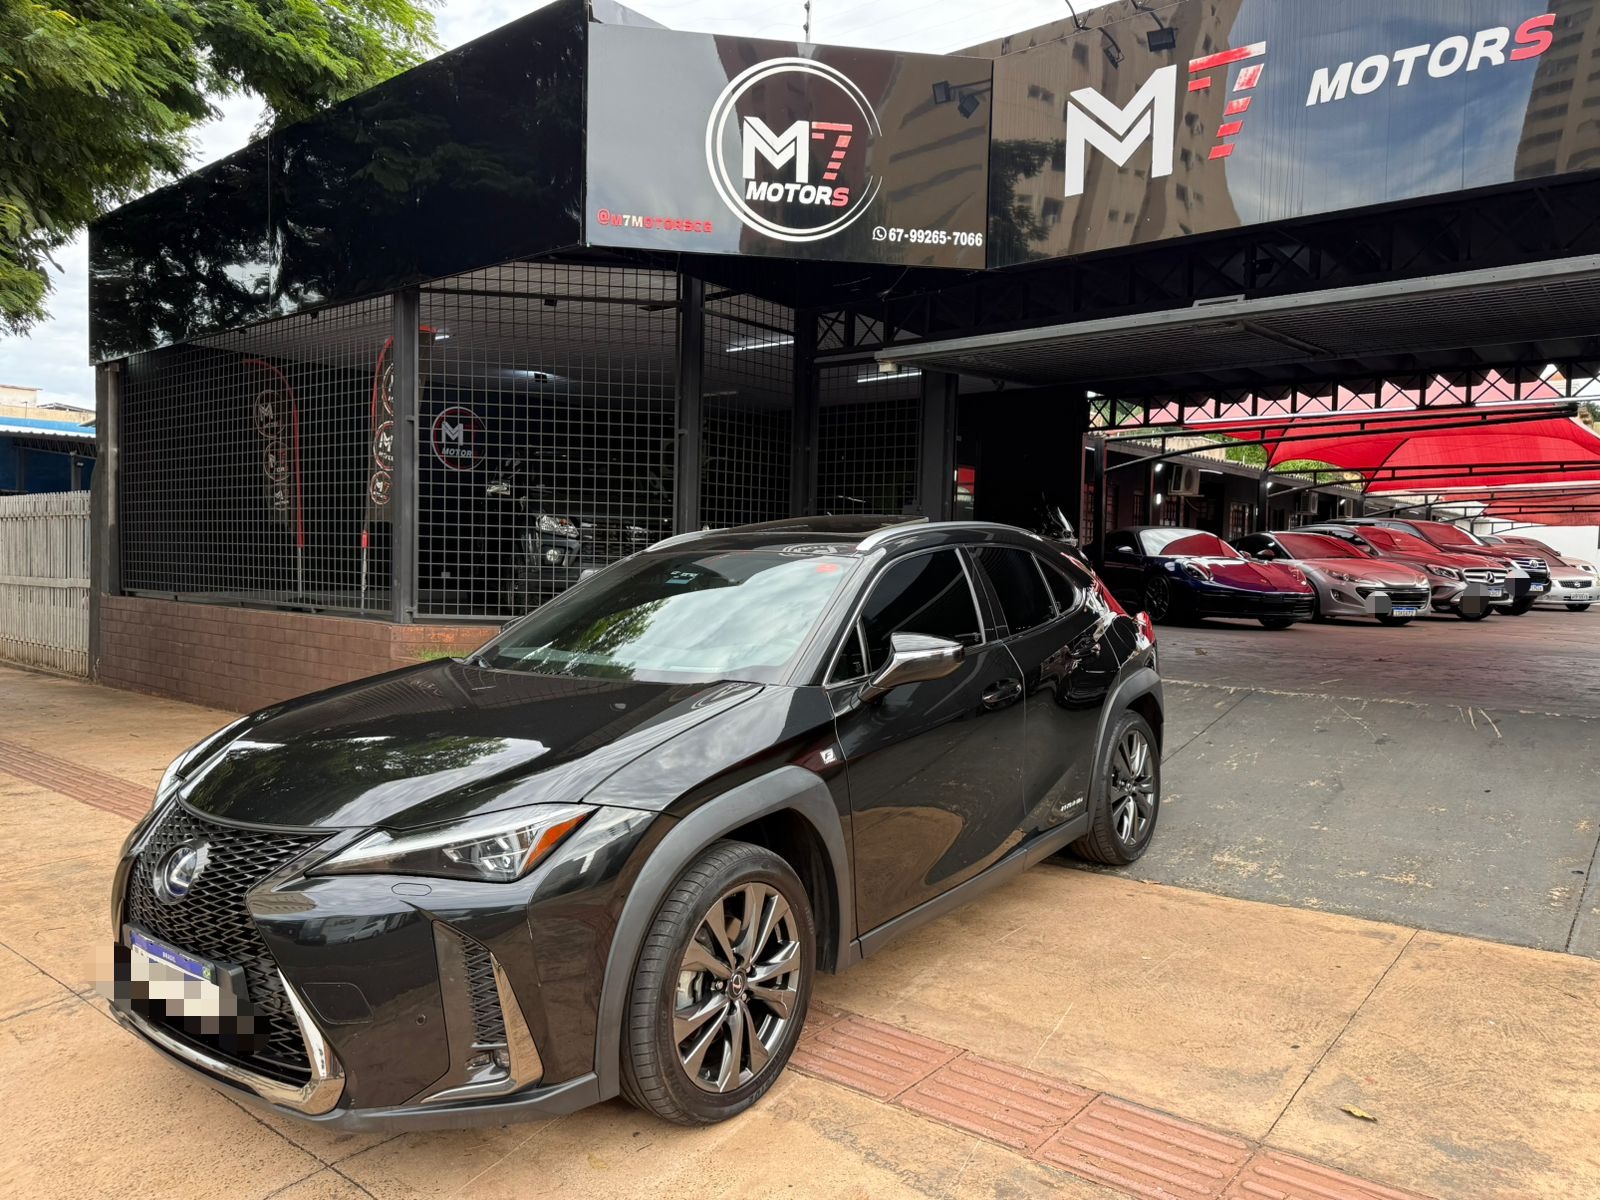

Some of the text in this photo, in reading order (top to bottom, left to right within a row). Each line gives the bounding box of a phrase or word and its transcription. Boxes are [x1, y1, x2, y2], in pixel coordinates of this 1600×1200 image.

[1065, 13, 1556, 197] M7 MOTORS
[742, 116, 852, 183] M7
[745, 180, 850, 207] MOTORS
[888, 227, 983, 247] 67-99265-7066
